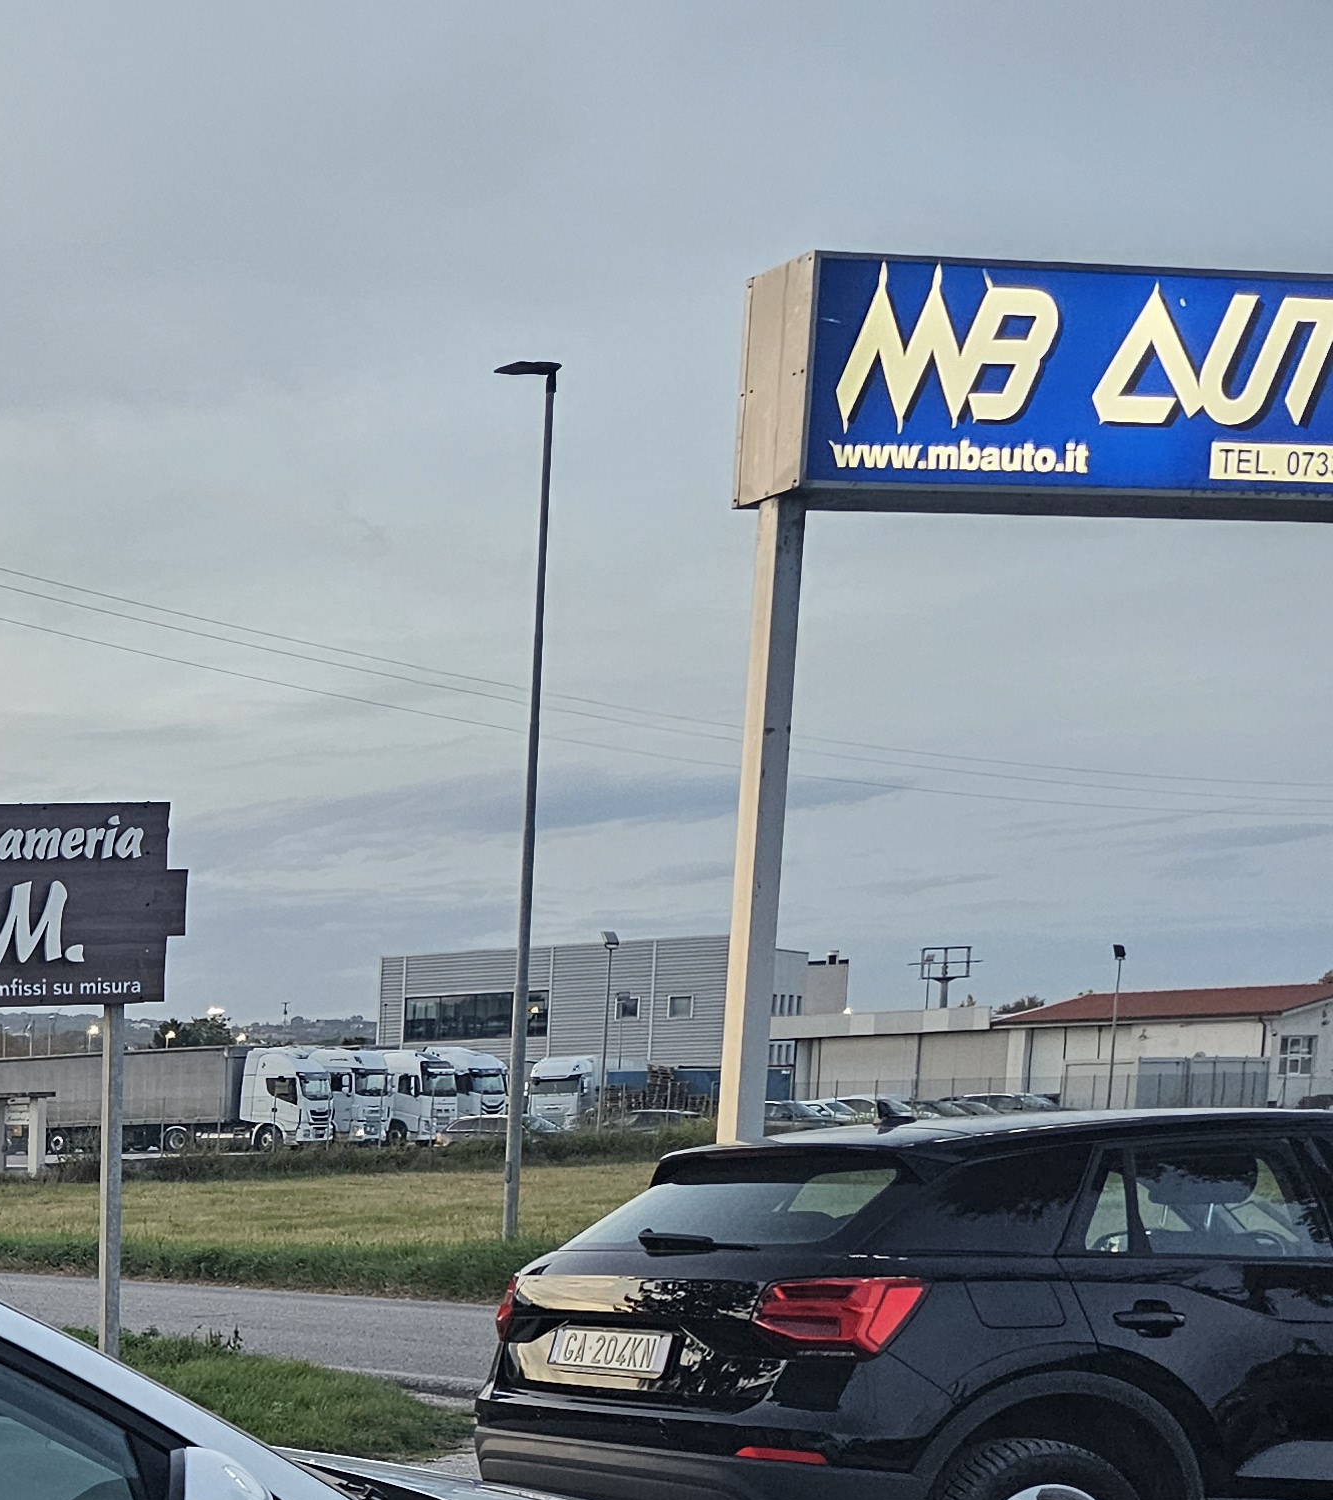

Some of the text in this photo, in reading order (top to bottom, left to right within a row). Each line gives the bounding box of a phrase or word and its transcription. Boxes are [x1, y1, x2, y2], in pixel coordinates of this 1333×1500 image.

[835, 261, 1059, 435] MB
[829, 438, 1088, 474] www.mbauto.it
[1219, 448, 1333, 477] TEL. 073
[53, 982, 73, 995] su
[80, 976, 141, 995] misura
[562, 1332, 657, 1369] GA 204KN
